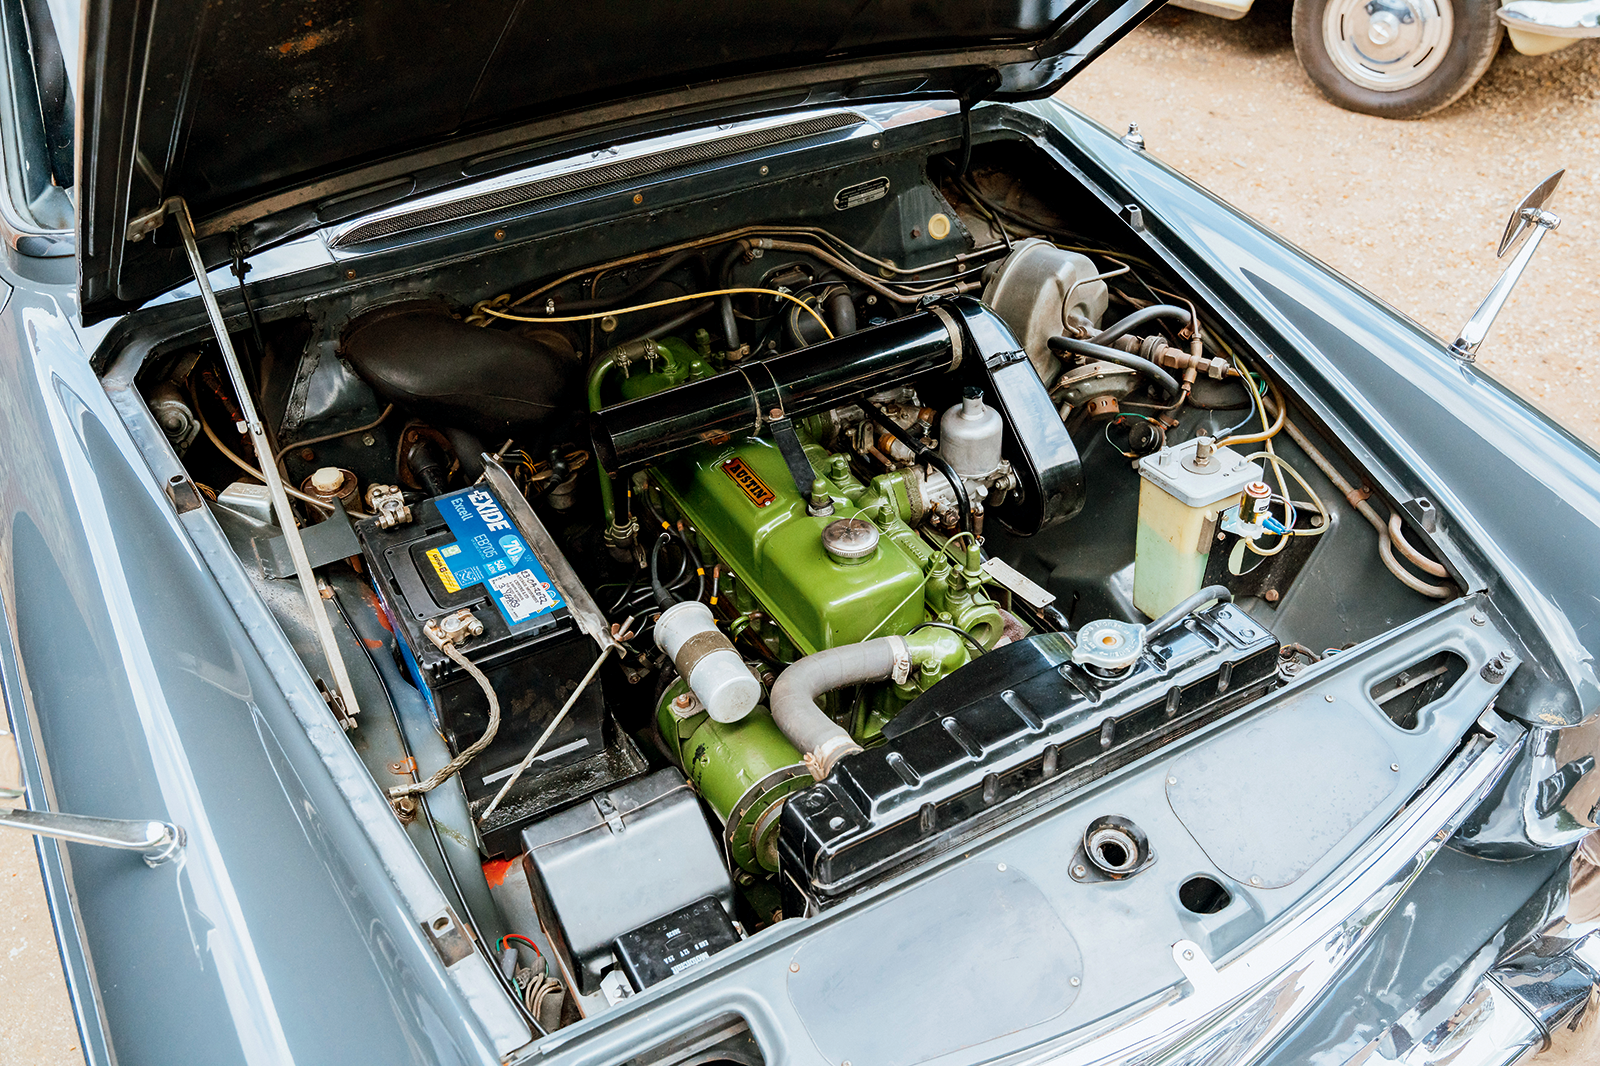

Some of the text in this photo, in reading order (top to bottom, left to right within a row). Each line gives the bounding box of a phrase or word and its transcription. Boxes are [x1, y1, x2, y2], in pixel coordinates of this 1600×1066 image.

[729, 464, 767, 499] AUSTIN
[451, 497, 474, 521] Excell
[468, 490, 511, 532] EXIDE
[474, 533, 498, 558] EB705
[503, 540, 523, 555] 70
[493, 560, 507, 571] 540
[670, 951, 710, 976] Motorcraft
